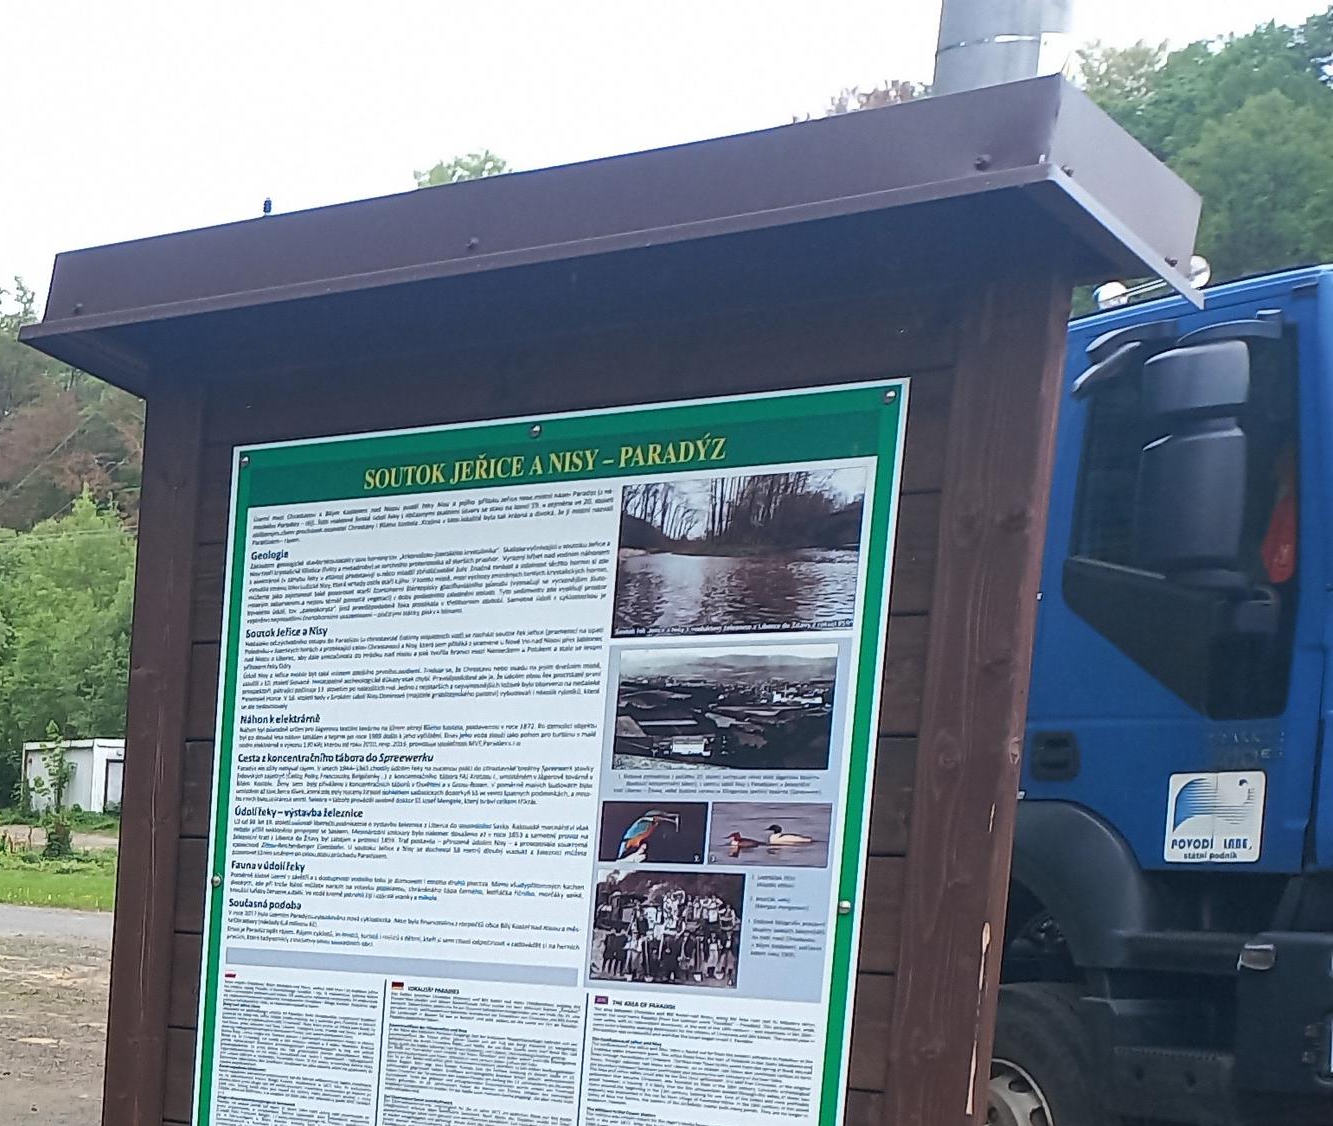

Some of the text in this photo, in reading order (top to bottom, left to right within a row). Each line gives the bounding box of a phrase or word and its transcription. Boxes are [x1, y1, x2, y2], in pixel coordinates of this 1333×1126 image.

[364, 463, 447, 490] SOUTOK
[450, 454, 525, 485] JEŘICE
[529, 460, 543, 476] A
[549, 449, 599, 475] NISY
[618, 433, 727, 469] PARADÝZ
[251, 549, 289, 561] Geologie
[246, 627, 275, 639] Soutok
[276, 627, 301, 638] Jeřice
[309, 626, 329, 637] Nisy
[240, 714, 268, 724] Náhon
[269, 714, 275, 723] k
[238, 753, 261, 763] Cesta
[267, 752, 334, 763] koncentračního
[335, 753, 365, 763] tábora
[365, 753, 378, 762] do
[378, 753, 434, 764] Spreewerku
[235, 805, 257, 817] Údolí
[258, 806, 277, 819] řeky
[284, 807, 322, 818] výstavba
[323, 807, 364, 818] železnice
[1171, 834, 1213, 850] POVODÍ
[1183, 851, 1237, 860] státní podnik
[231, 861, 257, 870] Fauna
[264, 860, 285, 870] údolí
[286, 861, 306, 873] řeky
[228, 899, 302, 911] Současná podoba
